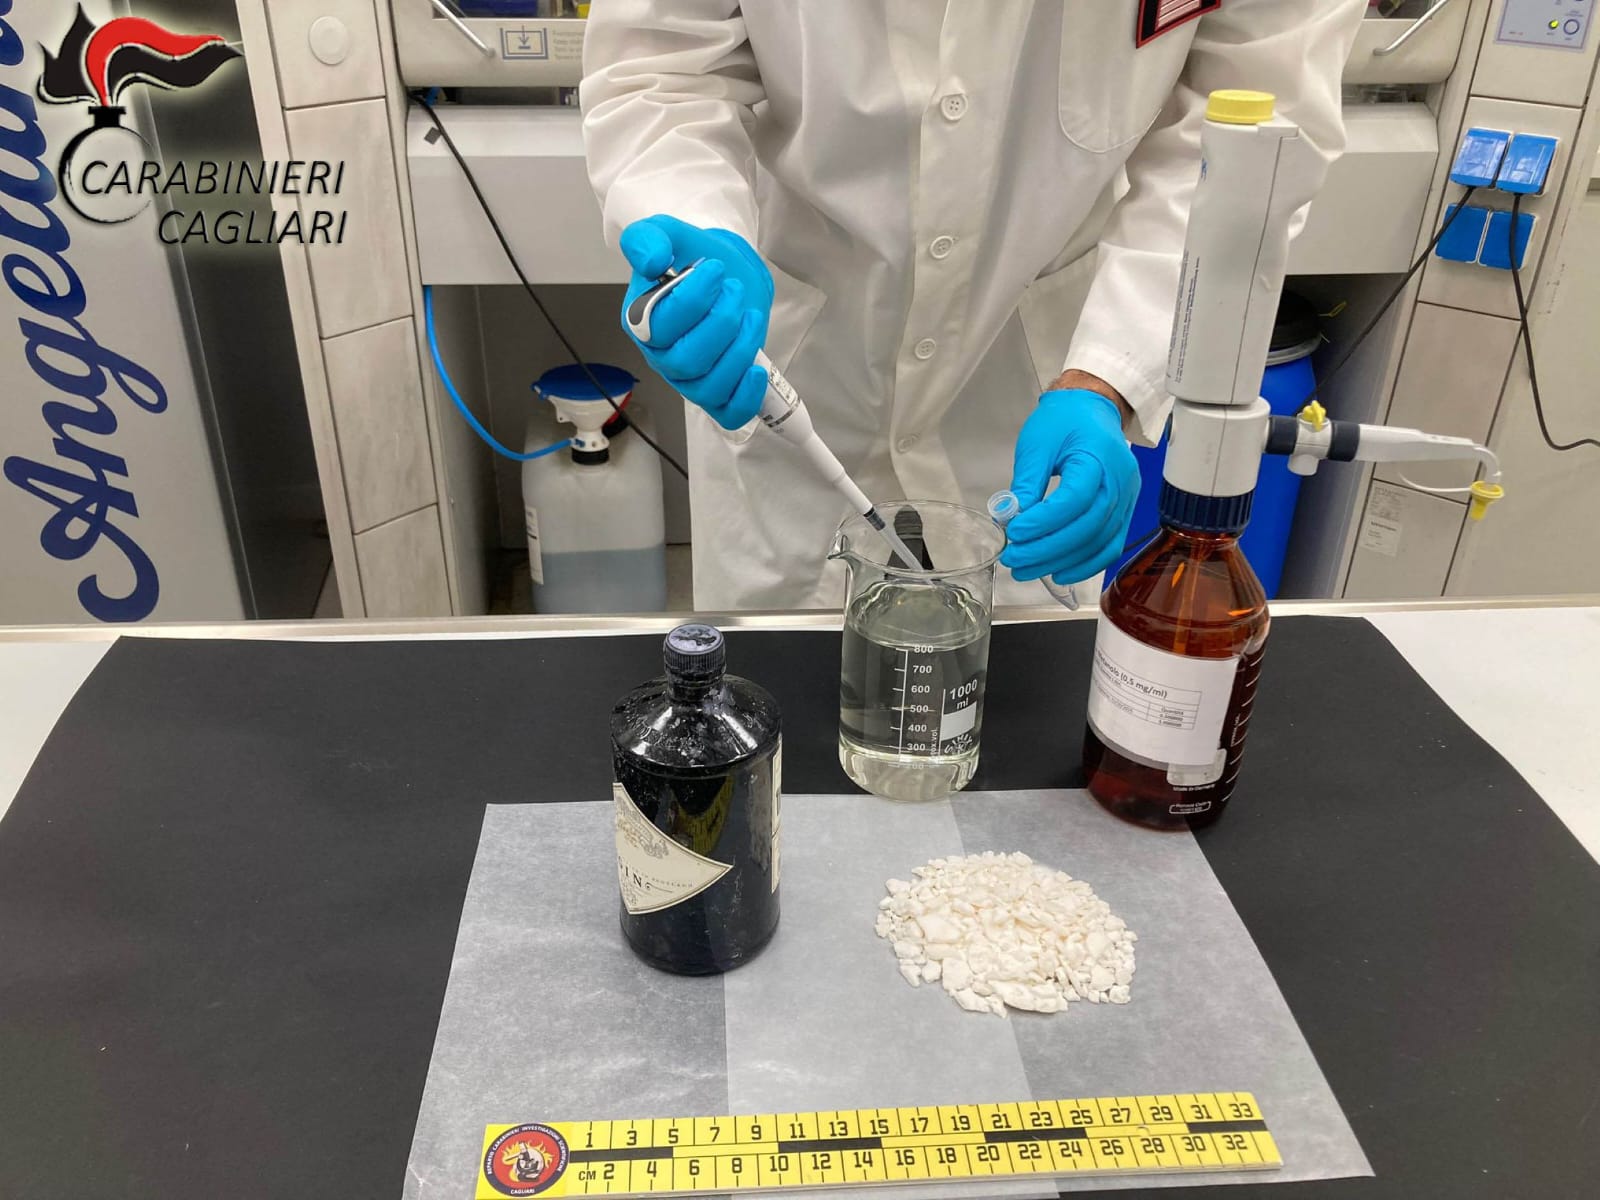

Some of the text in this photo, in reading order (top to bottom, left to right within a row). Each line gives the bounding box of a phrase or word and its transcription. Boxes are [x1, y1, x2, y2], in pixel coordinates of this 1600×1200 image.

[914, 645, 934, 654] 800
[912, 665, 932, 674] 700
[911, 685, 930, 694] 600
[950, 679, 978, 700] 1000
[1135, 682, 1168, 700] mg/ml)
[957, 697, 969, 710] ml
[910, 704, 929, 713] 500
[907, 724, 927, 732] 400
[907, 743, 926, 752] 300
[585, 1103, 1254, 1148] 1 3 5 7 9 11 13 15 17 19 21 23 25 27 29 31 33
[578, 1134, 1248, 1181] CM 2 4 6 8 10 12 14 16 18 20 22 24 26 28 30 32
